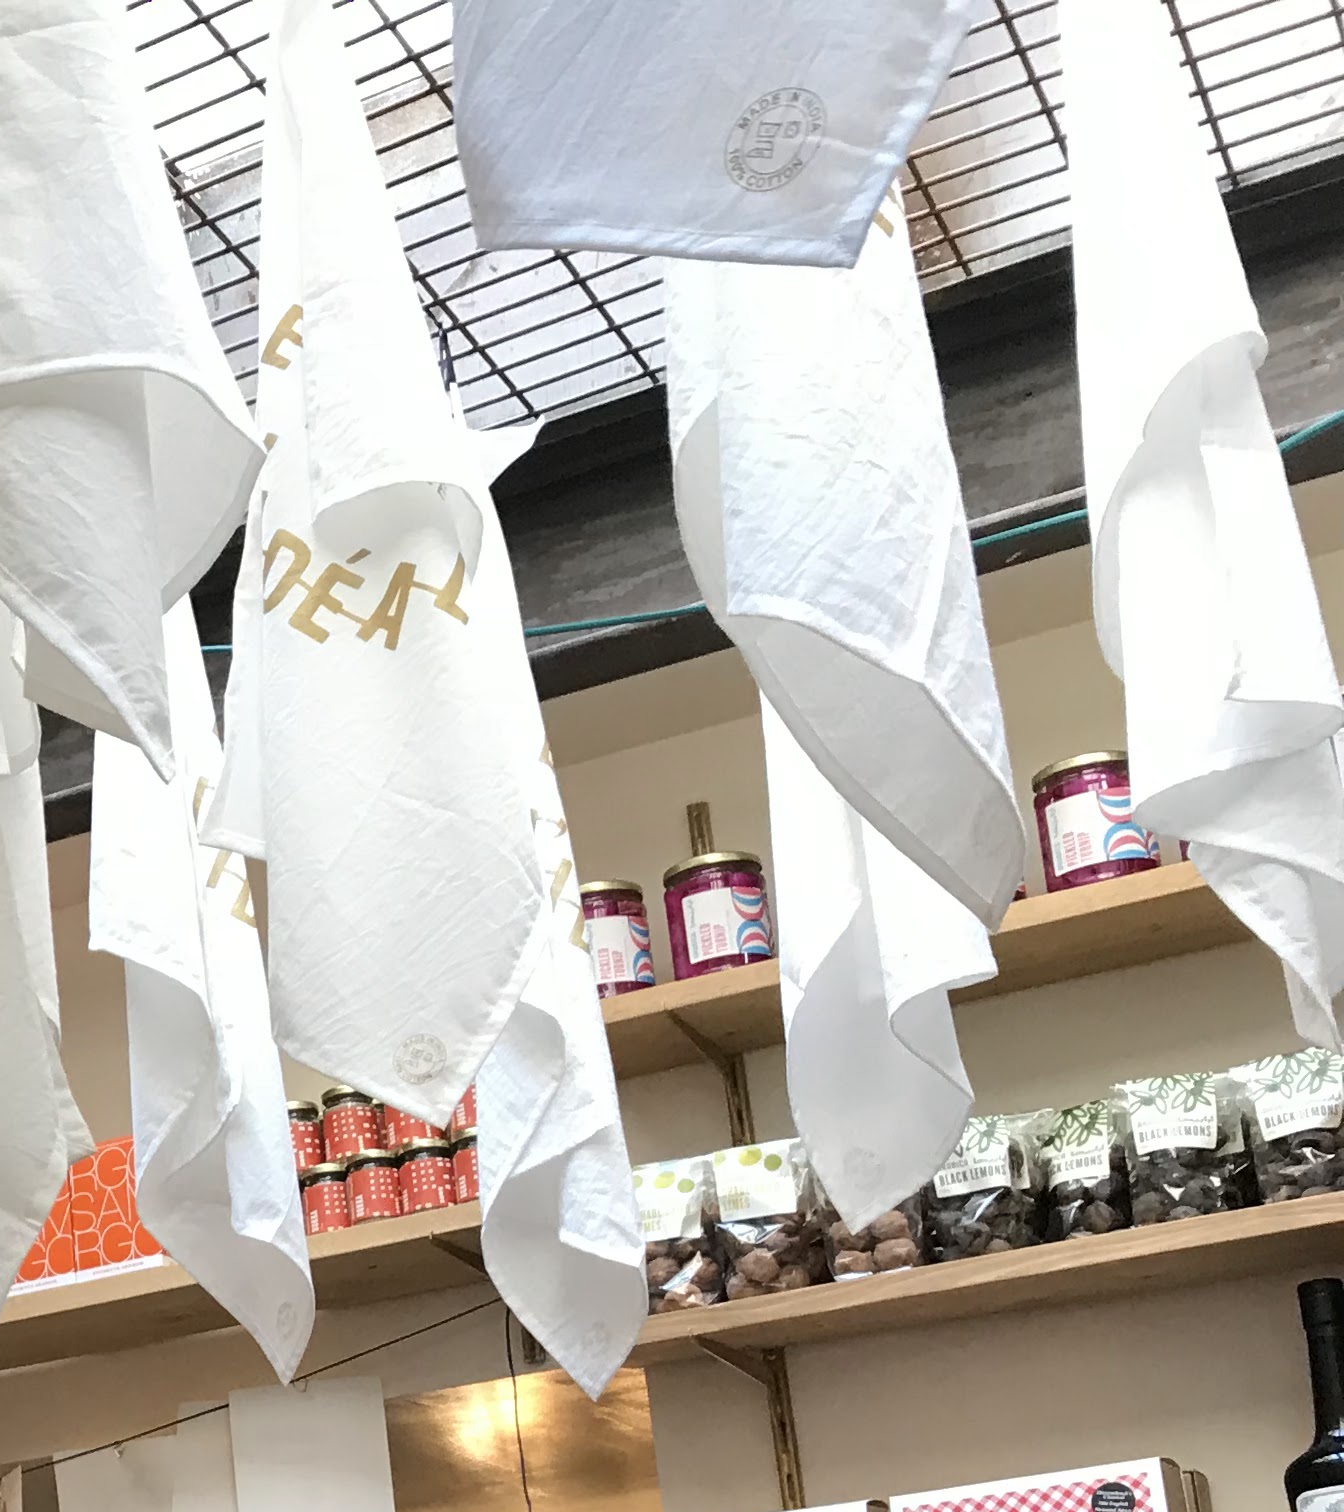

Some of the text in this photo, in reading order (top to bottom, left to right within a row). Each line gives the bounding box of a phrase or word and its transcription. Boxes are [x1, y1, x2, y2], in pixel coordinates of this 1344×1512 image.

[1263, 1112, 1297, 1129] BLACK
[1138, 1127, 1169, 1144] BLACK
[938, 1163, 1008, 1188] BLACK LEMONS
